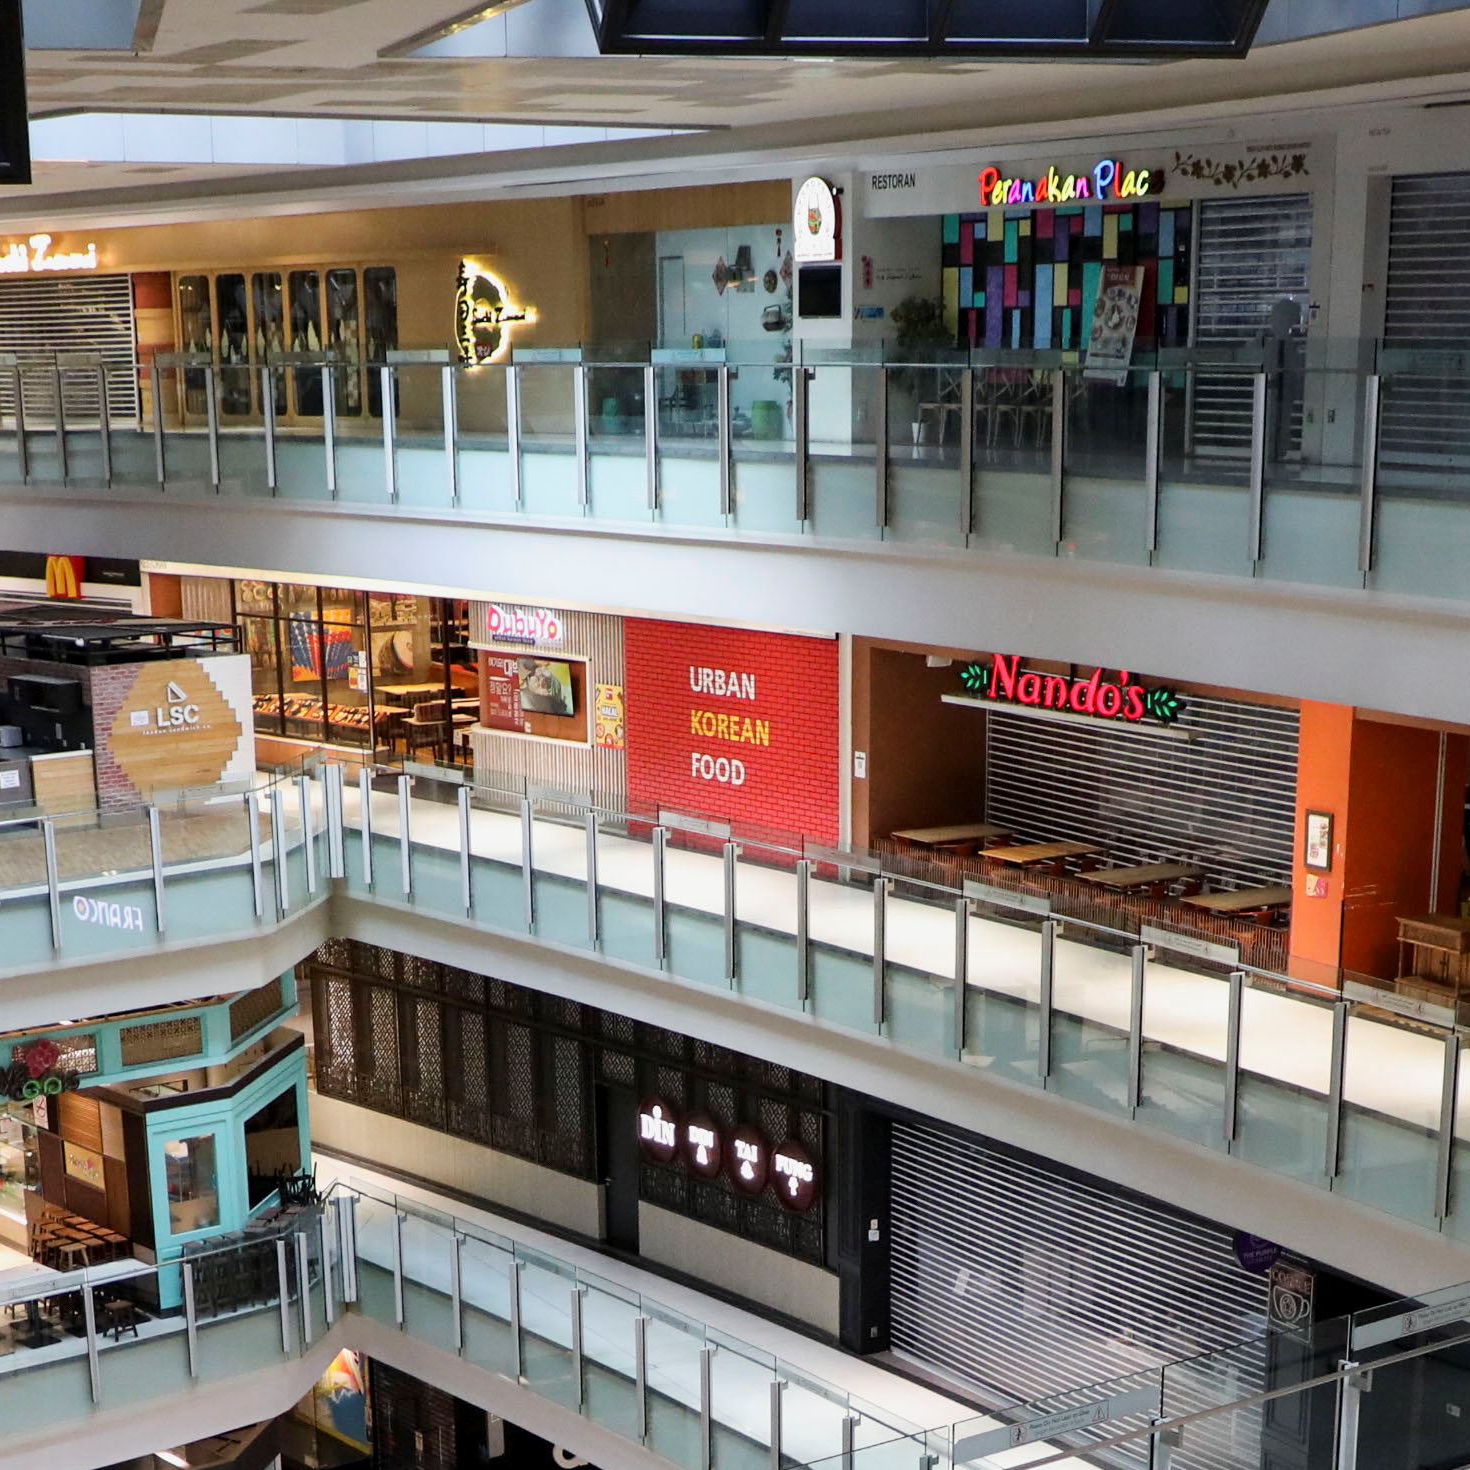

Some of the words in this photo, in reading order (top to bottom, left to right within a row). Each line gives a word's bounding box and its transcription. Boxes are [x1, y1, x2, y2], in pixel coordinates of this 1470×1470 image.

[871, 173, 916, 190] RESTORAN
[978, 166, 1091, 206] Peranakan
[1093, 159, 1166, 200] Place
[689, 665, 756, 700] URBAN
[987, 653, 1146, 720] Nando's
[156, 704, 200, 728] LSC
[690, 709, 770, 747] KOREAN
[691, 752, 746, 786] FOOD
